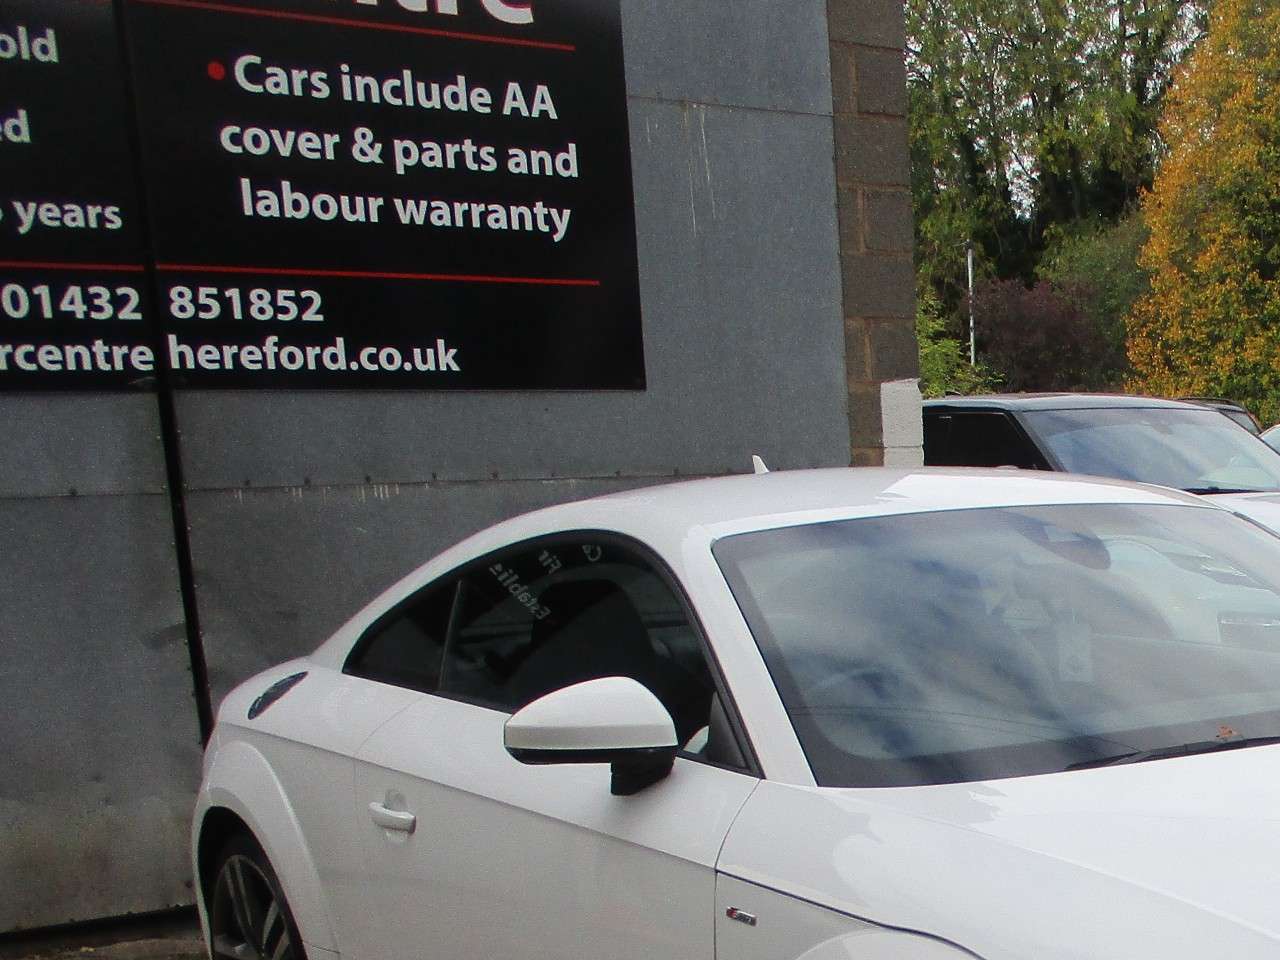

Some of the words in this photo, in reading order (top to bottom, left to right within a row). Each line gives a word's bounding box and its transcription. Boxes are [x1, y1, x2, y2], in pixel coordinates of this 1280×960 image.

[234, 54, 330, 99] Cars
[340, 63, 492, 114] include
[502, 81, 559, 120] AA
[220, 125, 340, 161] cover
[351, 127, 384, 164] &
[393, 138, 498, 175] parts
[507, 142, 579, 178] and
[12, 201, 123, 235] years
[240, 178, 384, 223] labour
[393, 198, 573, 243] warranty
[1, 283, 143, 321] 01432
[169, 285, 325, 322] 851852
[167, 334, 461, 372] hereford.co.uk
